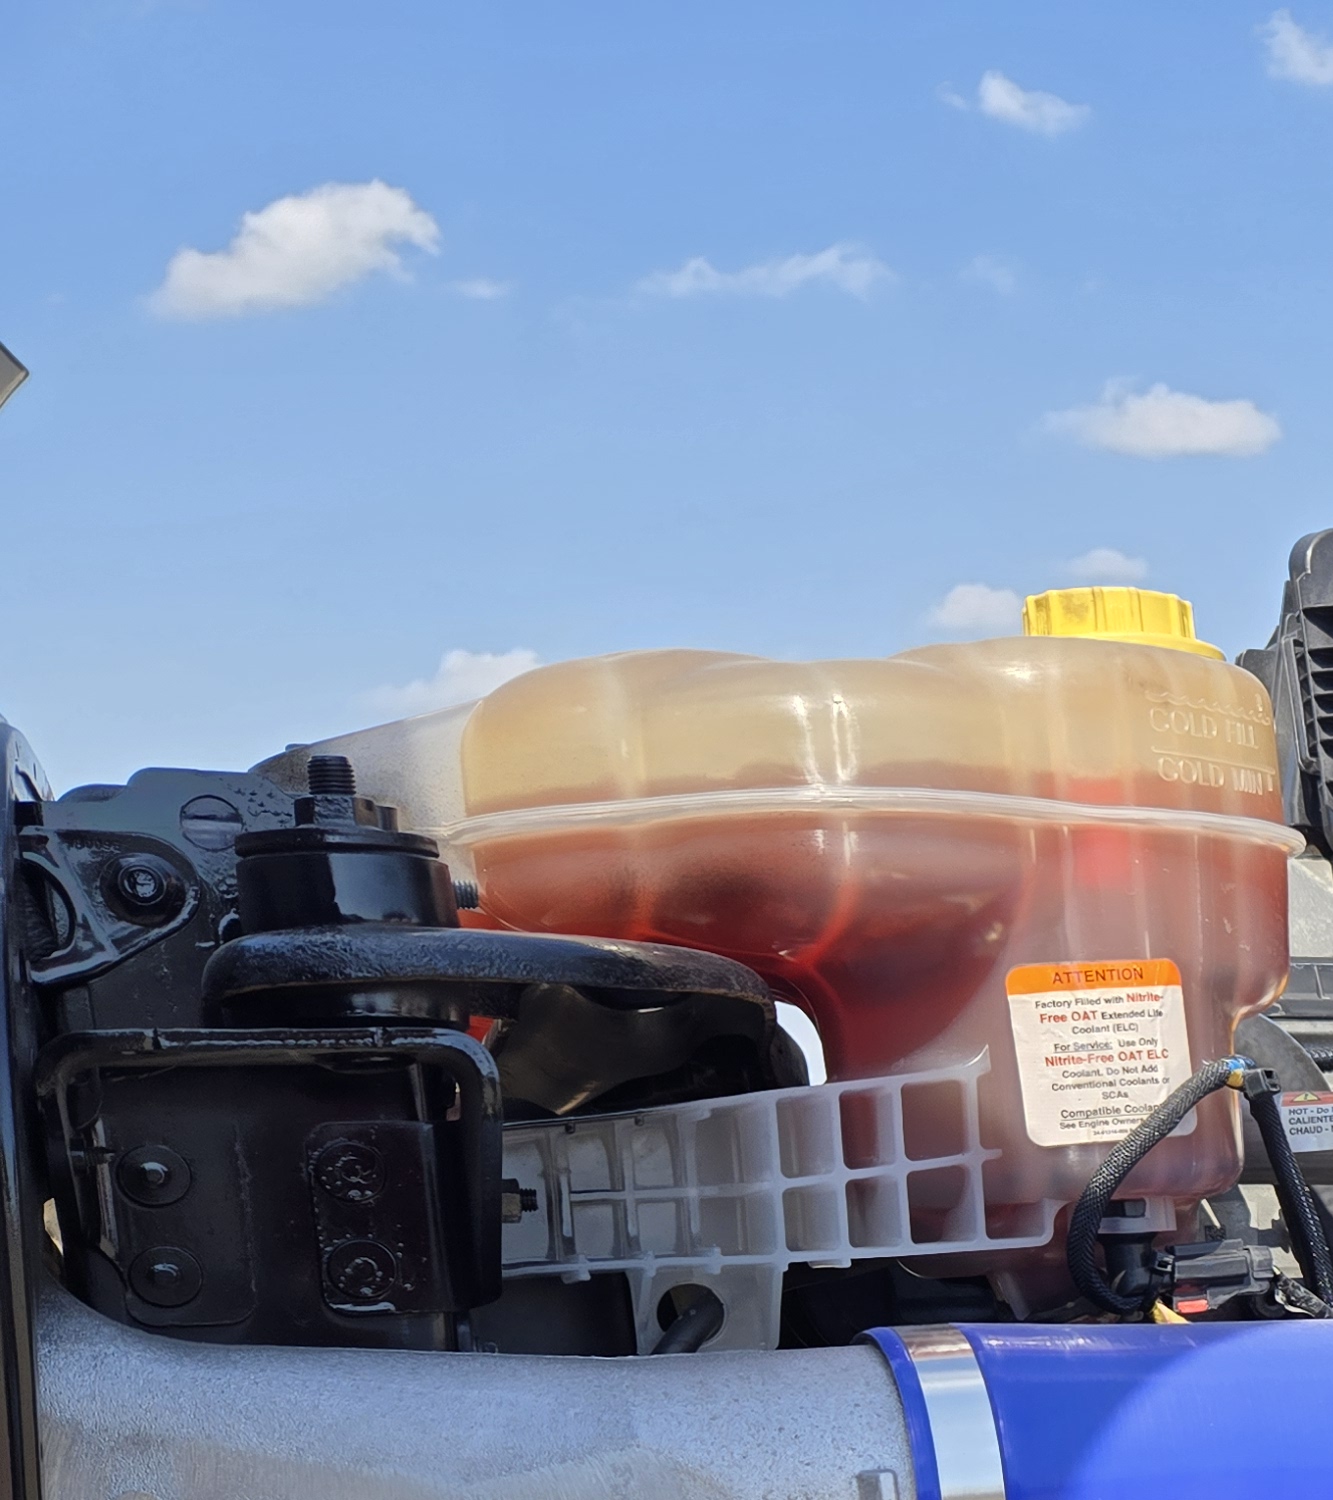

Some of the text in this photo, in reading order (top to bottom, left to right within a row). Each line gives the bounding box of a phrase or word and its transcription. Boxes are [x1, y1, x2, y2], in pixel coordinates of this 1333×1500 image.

[1149, 707, 1259, 750] COLD FILL
[1156, 756, 1225, 789] COLD
[1052, 967, 1144, 985] ATTENTION
[1035, 993, 1164, 1009] Factory Filled with Nitrite-
[1039, 1008, 1163, 1024] Free OAT Extended Life
[1072, 1023, 1139, 1035] Coolant (ELC)
[1054, 1038, 1158, 1052] For Service: Use Only
[1045, 1048, 1169, 1067] Nitrite-Free OAT ELC
[1107, 1067, 1120, 1076] Do
[1122, 1066, 1139, 1074] Not
[1141, 1064, 1159, 1073] Add
[1052, 1078, 1117, 1092] Conventional
[1119, 1078, 1159, 1088] Coolants
[1102, 1091, 1129, 1100] SCAs
[1061, 1104, 1121, 1120] Compatible
[1060, 1118, 1109, 1130] See Engine
[1289, 1125, 1323, 1135] CHAUD
